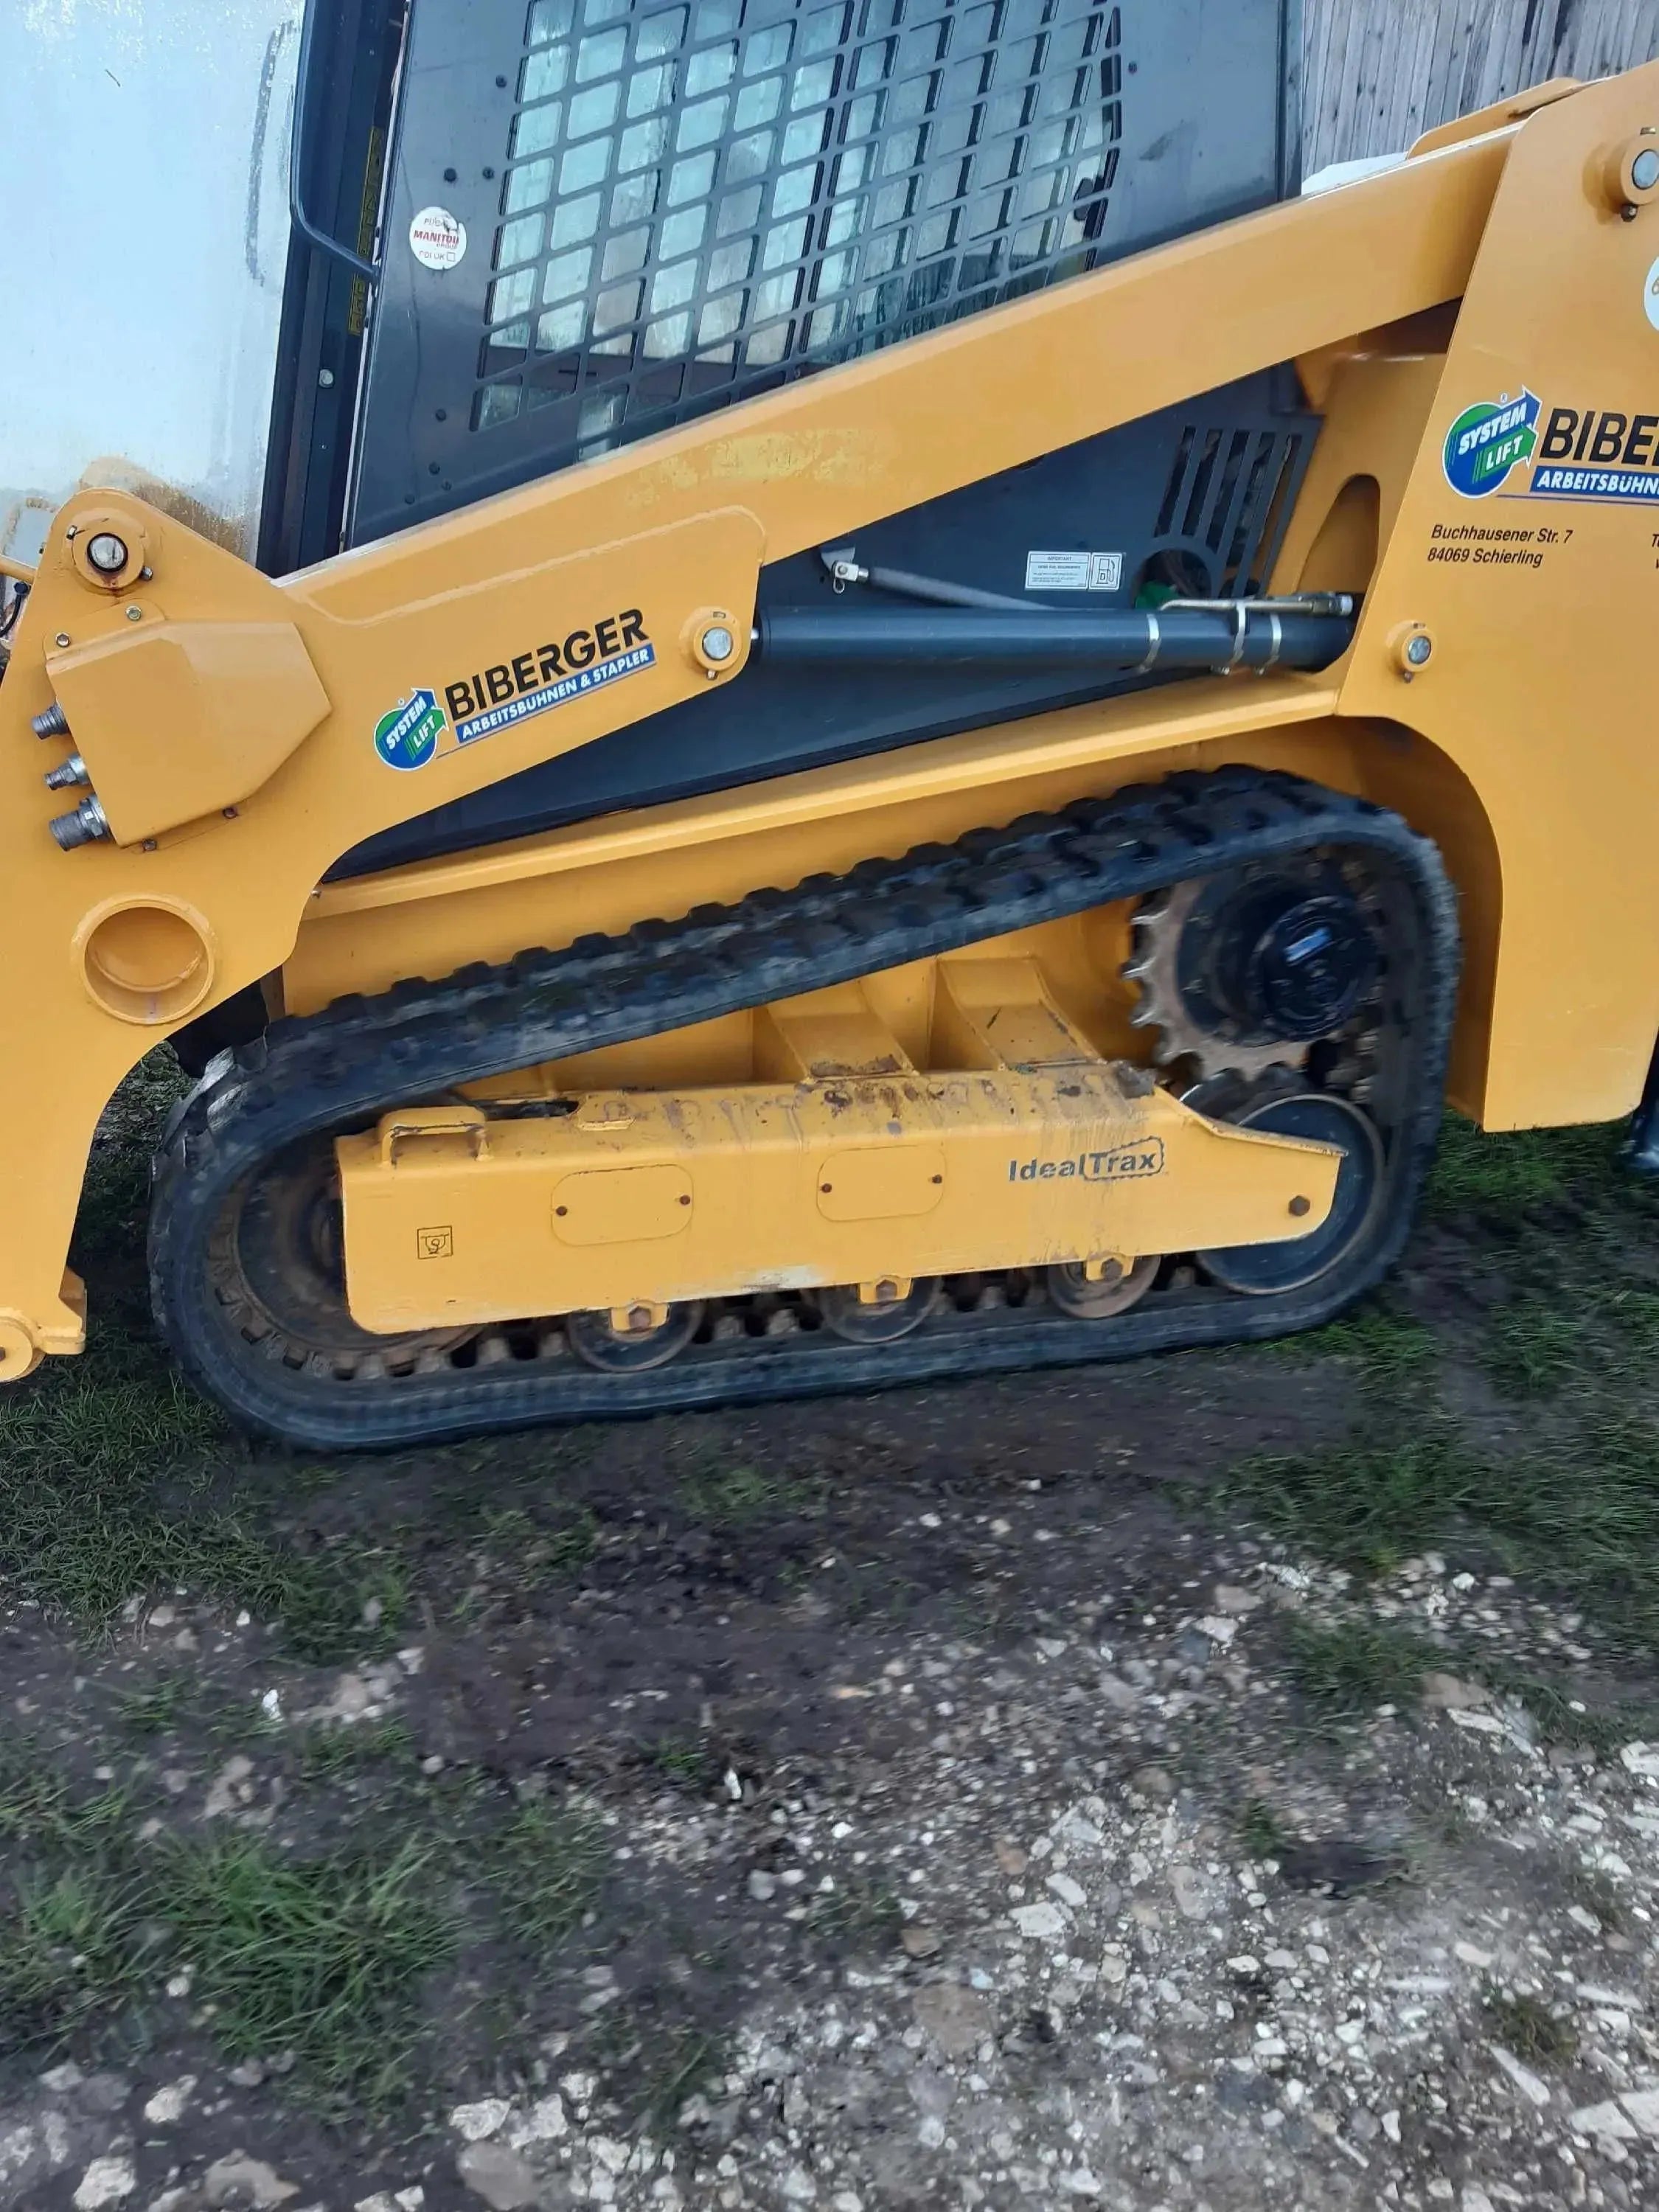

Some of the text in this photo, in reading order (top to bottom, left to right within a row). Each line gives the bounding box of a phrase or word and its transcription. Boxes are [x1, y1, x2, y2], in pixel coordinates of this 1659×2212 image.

[414, 229, 459, 245] MANITOU
[1458, 402, 1527, 455] SYSTEM
[1540, 408, 1659, 466] BIBE
[1486, 434, 1524, 470] LIFT
[1537, 470, 1659, 495] ARBEITSBÜHN
[1431, 524, 1573, 543] Buchhausener Str. 7
[1427, 547, 1543, 568] 84069 Schierling
[445, 608, 650, 721] BIBERGER
[580, 674, 591, 688] &
[593, 649, 650, 685] STAPLER
[386, 696, 427, 750] SYSTEM
[413, 715, 435, 749] LIFT
